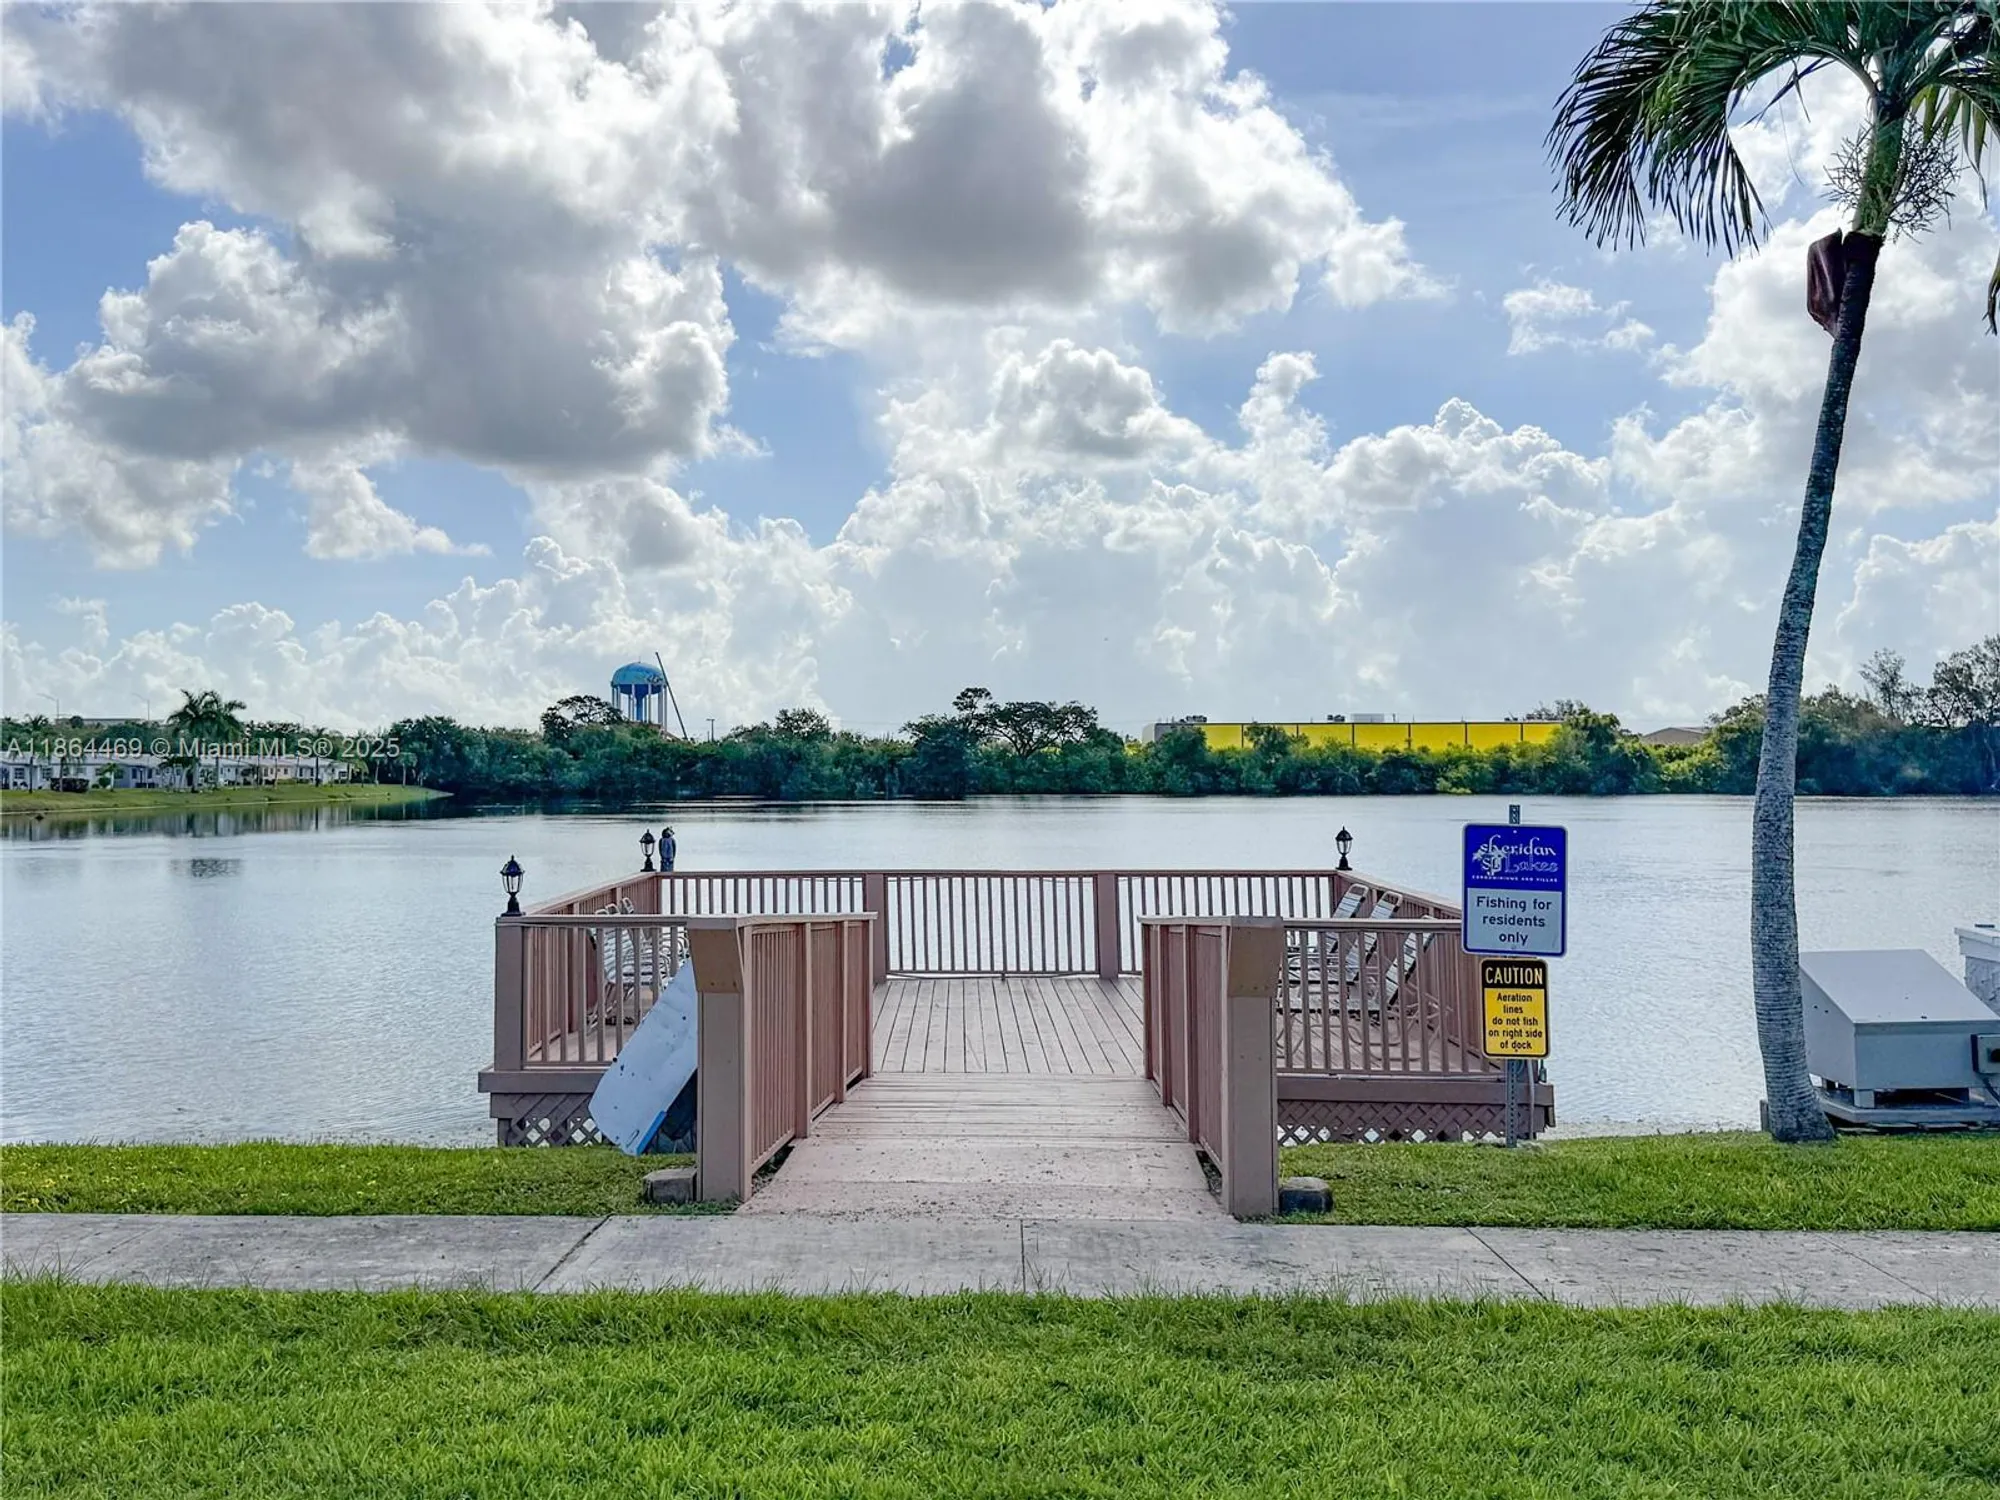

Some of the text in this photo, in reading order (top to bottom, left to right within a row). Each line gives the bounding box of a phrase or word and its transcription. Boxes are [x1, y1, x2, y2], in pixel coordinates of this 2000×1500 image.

[1476, 896, 1552, 912] Fishing for
[1482, 914, 1546, 927] residents
[1499, 931, 1528, 946] only
[1485, 967, 1543, 985] CAUTION
[1497, 993, 1533, 1002] Aeration
[1503, 1005, 1523, 1014] lines
[1492, 1017, 1539, 1026] do not fish
[1502, 1029, 1523, 1039] right
[1526, 1030, 1543, 1038] side
[1500, 1041, 1532, 1050] of dock
